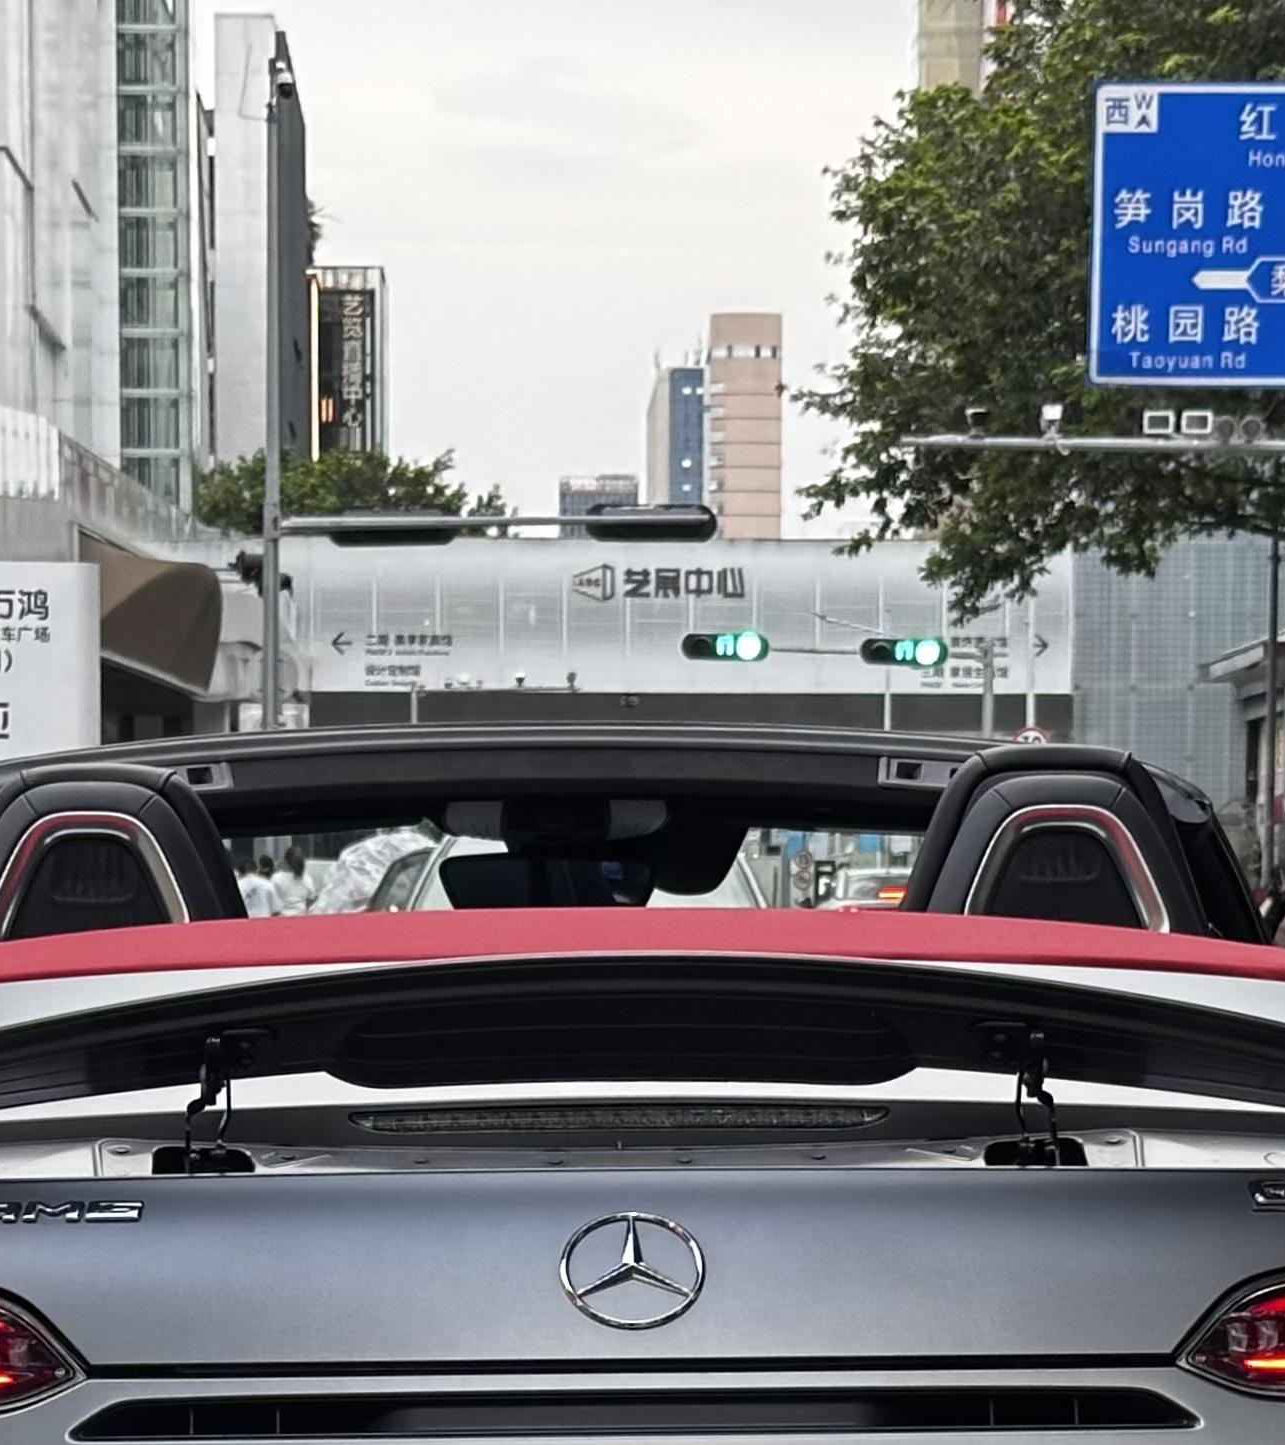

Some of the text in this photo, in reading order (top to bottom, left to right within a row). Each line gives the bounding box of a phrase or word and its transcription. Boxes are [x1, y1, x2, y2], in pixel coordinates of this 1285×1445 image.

[1105, 97, 1130, 126] 西
[1133, 93, 1155, 110] W
[1114, 189, 1263, 230] 笋岗路
[1128, 236, 1248, 257] Sungang Rd
[1112, 306, 1261, 344] 桃园路
[1129, 352, 1246, 372] Taoyuan Rd
[623, 568, 745, 598] 艺展中心
